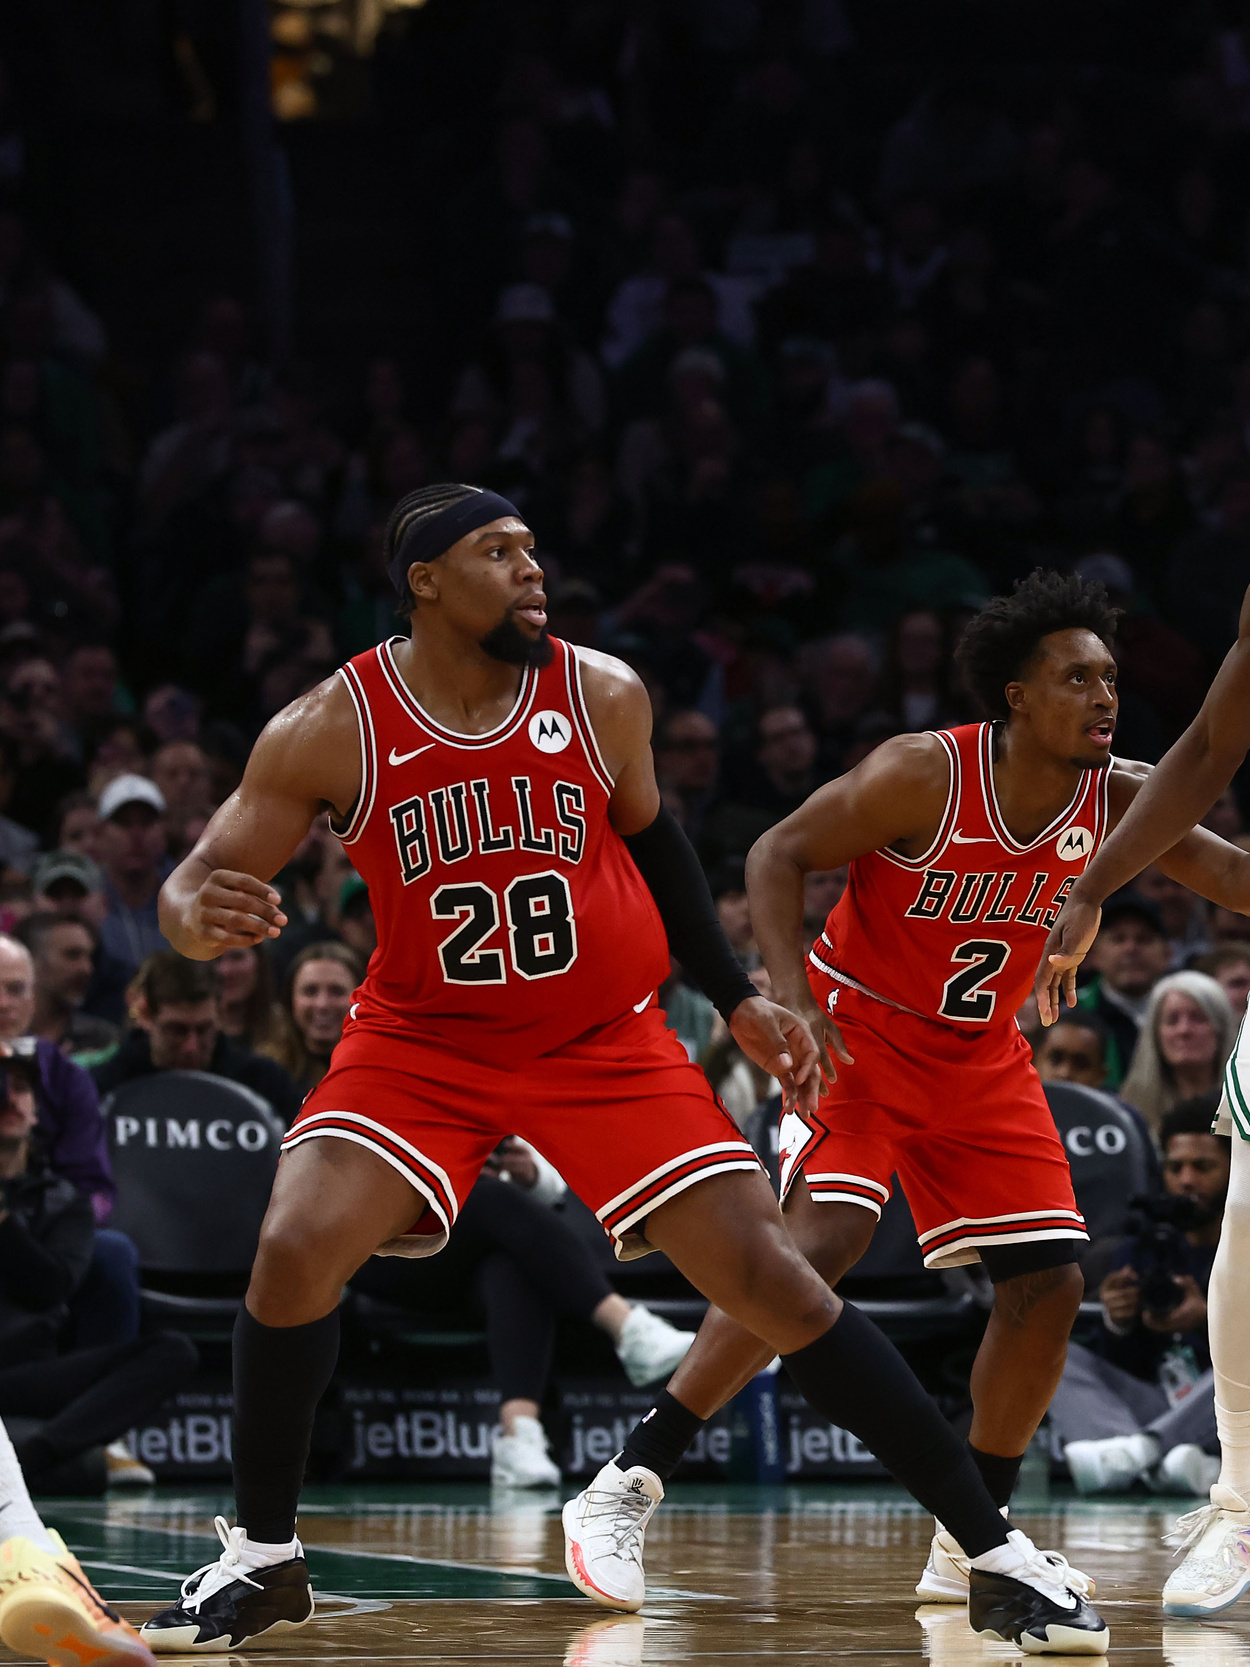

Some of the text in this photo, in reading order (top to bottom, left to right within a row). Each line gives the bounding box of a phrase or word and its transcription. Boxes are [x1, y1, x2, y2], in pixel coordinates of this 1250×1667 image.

[389, 776, 586, 886] BULLS
[429, 869, 578, 985] 28
[937, 938, 1012, 1023] 2
[115, 1115, 269, 1152] PIMCO
